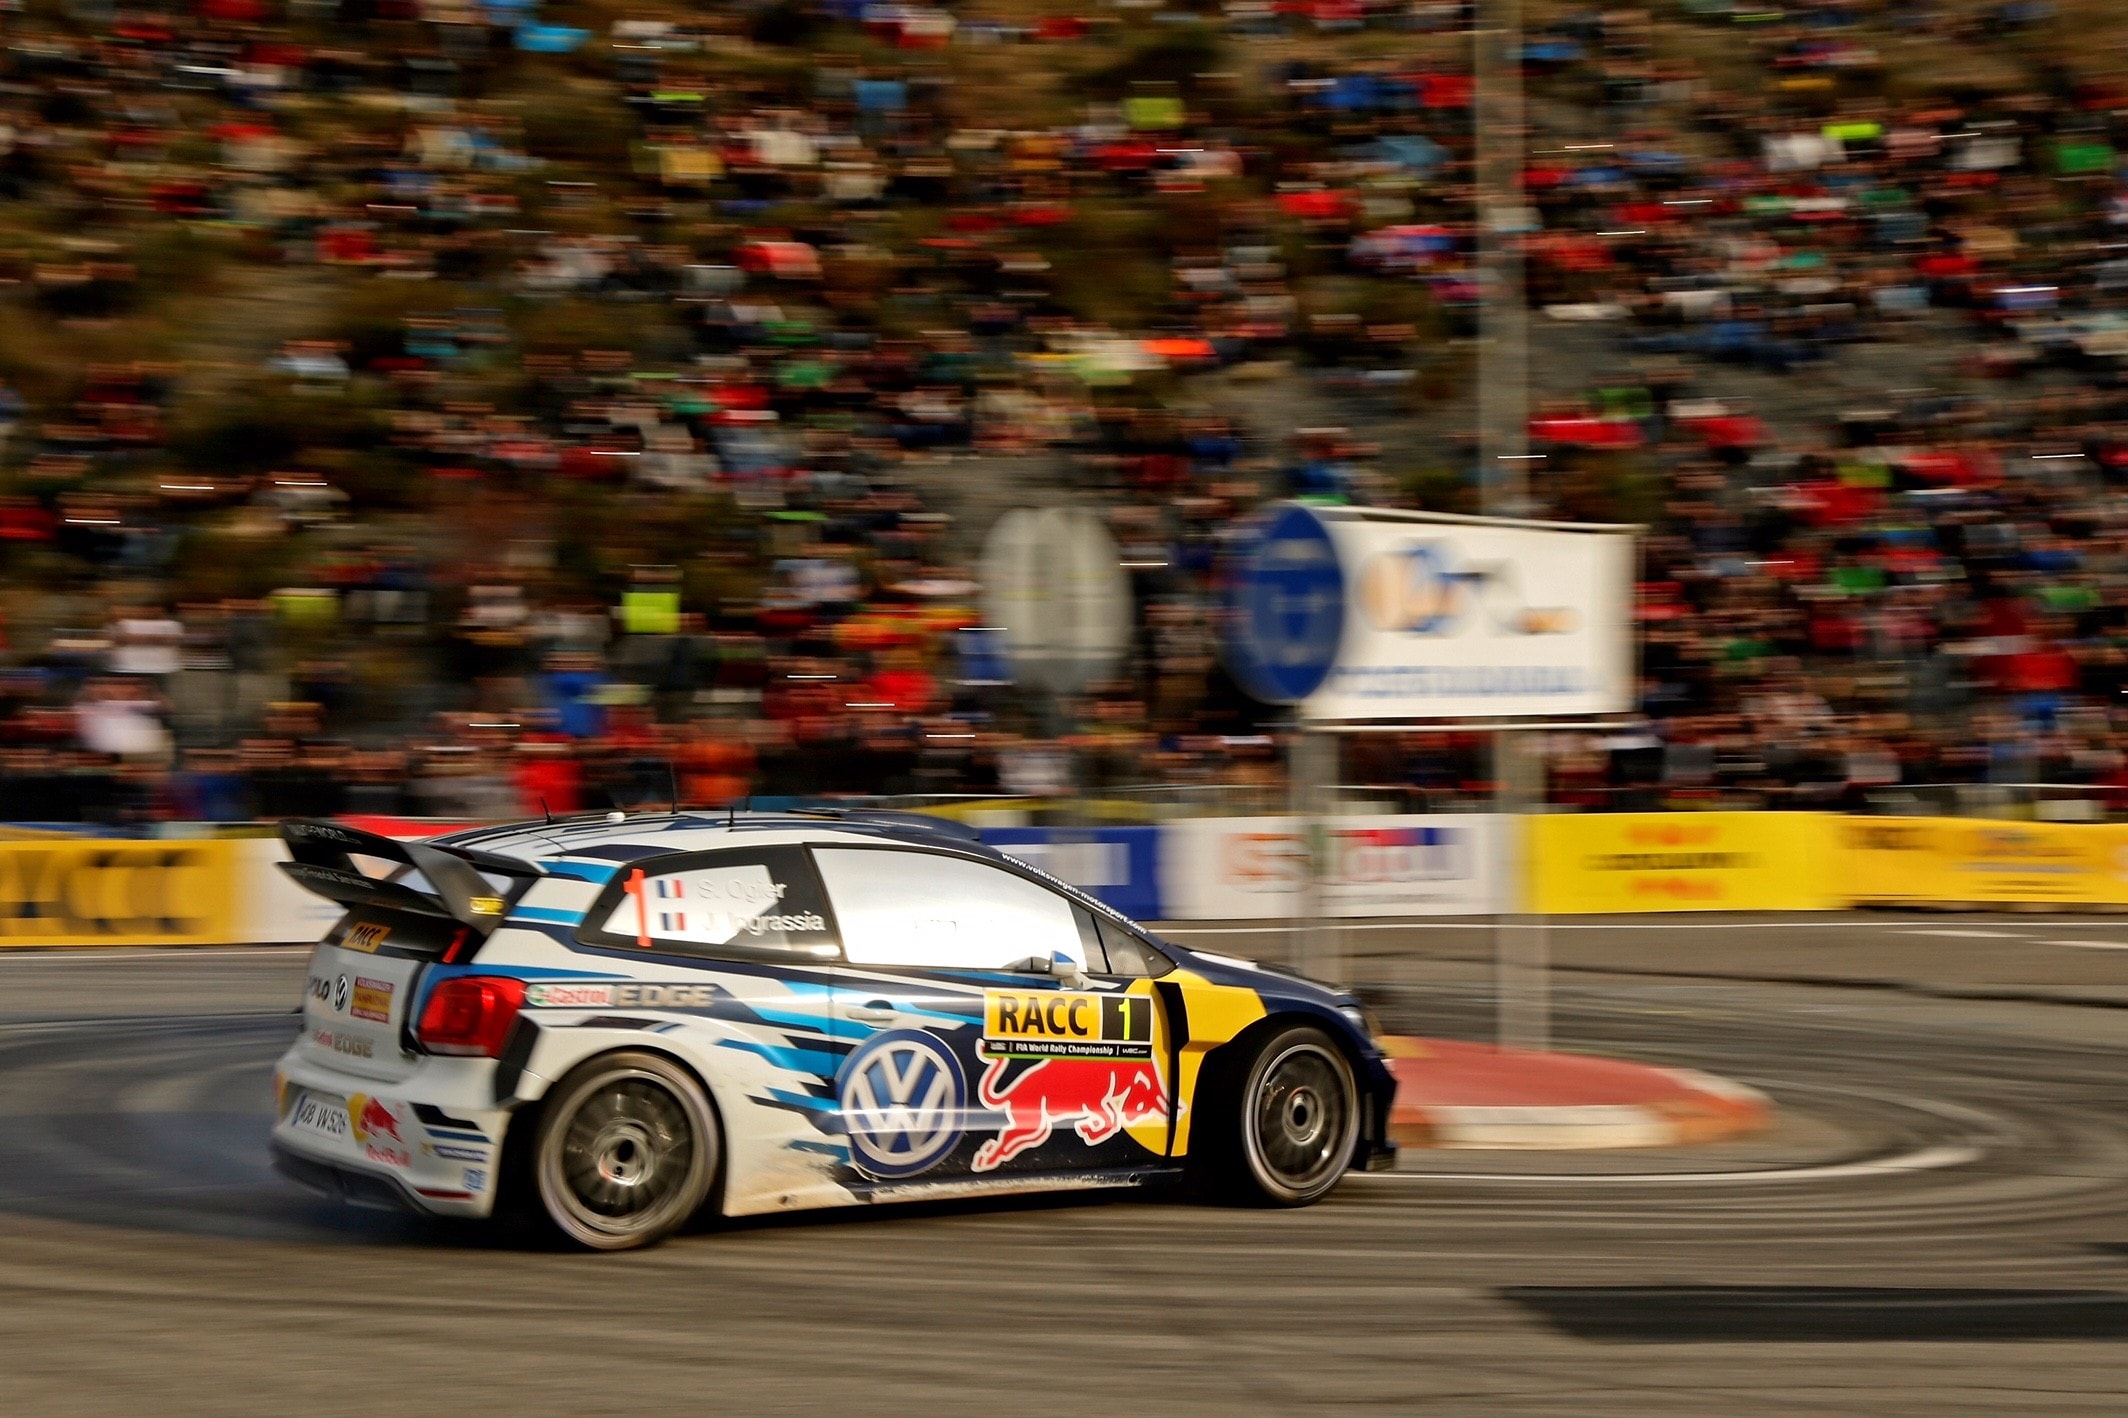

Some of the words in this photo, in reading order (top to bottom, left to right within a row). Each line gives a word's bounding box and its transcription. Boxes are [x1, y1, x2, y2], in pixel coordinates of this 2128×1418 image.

[726, 880, 787, 903] Ogier
[1001, 852, 1148, 935] www.volkswagen-motorsport.com
[623, 868, 652, 948] 1
[349, 925, 382, 947] RACC
[615, 985, 715, 1009] EDGE
[999, 995, 1088, 1036] RACC
[1118, 998, 1131, 1040] 1
[1016, 1043, 1028, 1052] FIA
[1029, 1043, 1049, 1053] World
[1050, 1044, 1066, 1054] Rally
[1067, 1045, 1113, 1055] Championship
